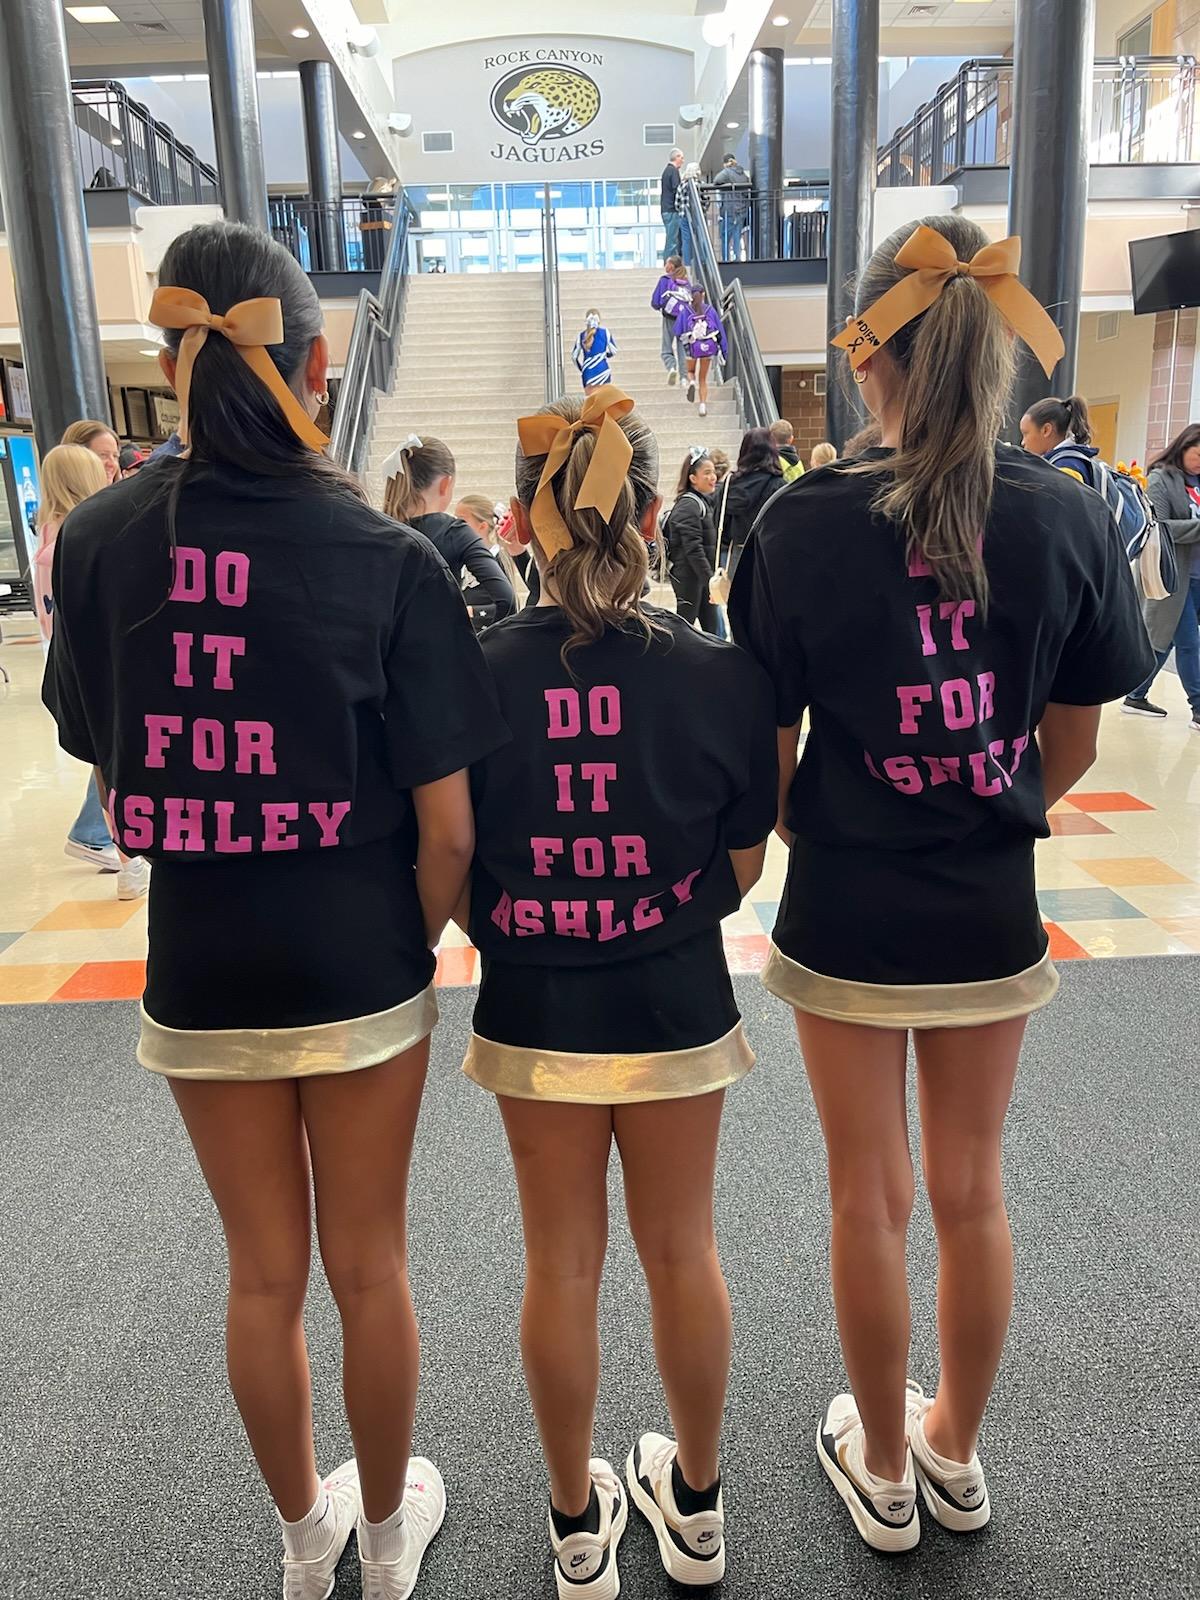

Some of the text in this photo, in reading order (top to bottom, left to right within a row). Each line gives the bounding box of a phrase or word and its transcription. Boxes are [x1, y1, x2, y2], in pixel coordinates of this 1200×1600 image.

[484, 49, 603, 69] ROCK CANYON
[490, 139, 604, 163] JAGUARS
[169, 546, 250, 607] DO
[916, 600, 975, 656] IT
[173, 632, 245, 690] IT
[544, 685, 621, 738] DO
[897, 671, 995, 734] FOR
[145, 714, 276, 774] FOR
[554, 763, 617, 812] IT
[108, 788, 351, 853] SHLEY
[530, 835, 651, 877] FOR
